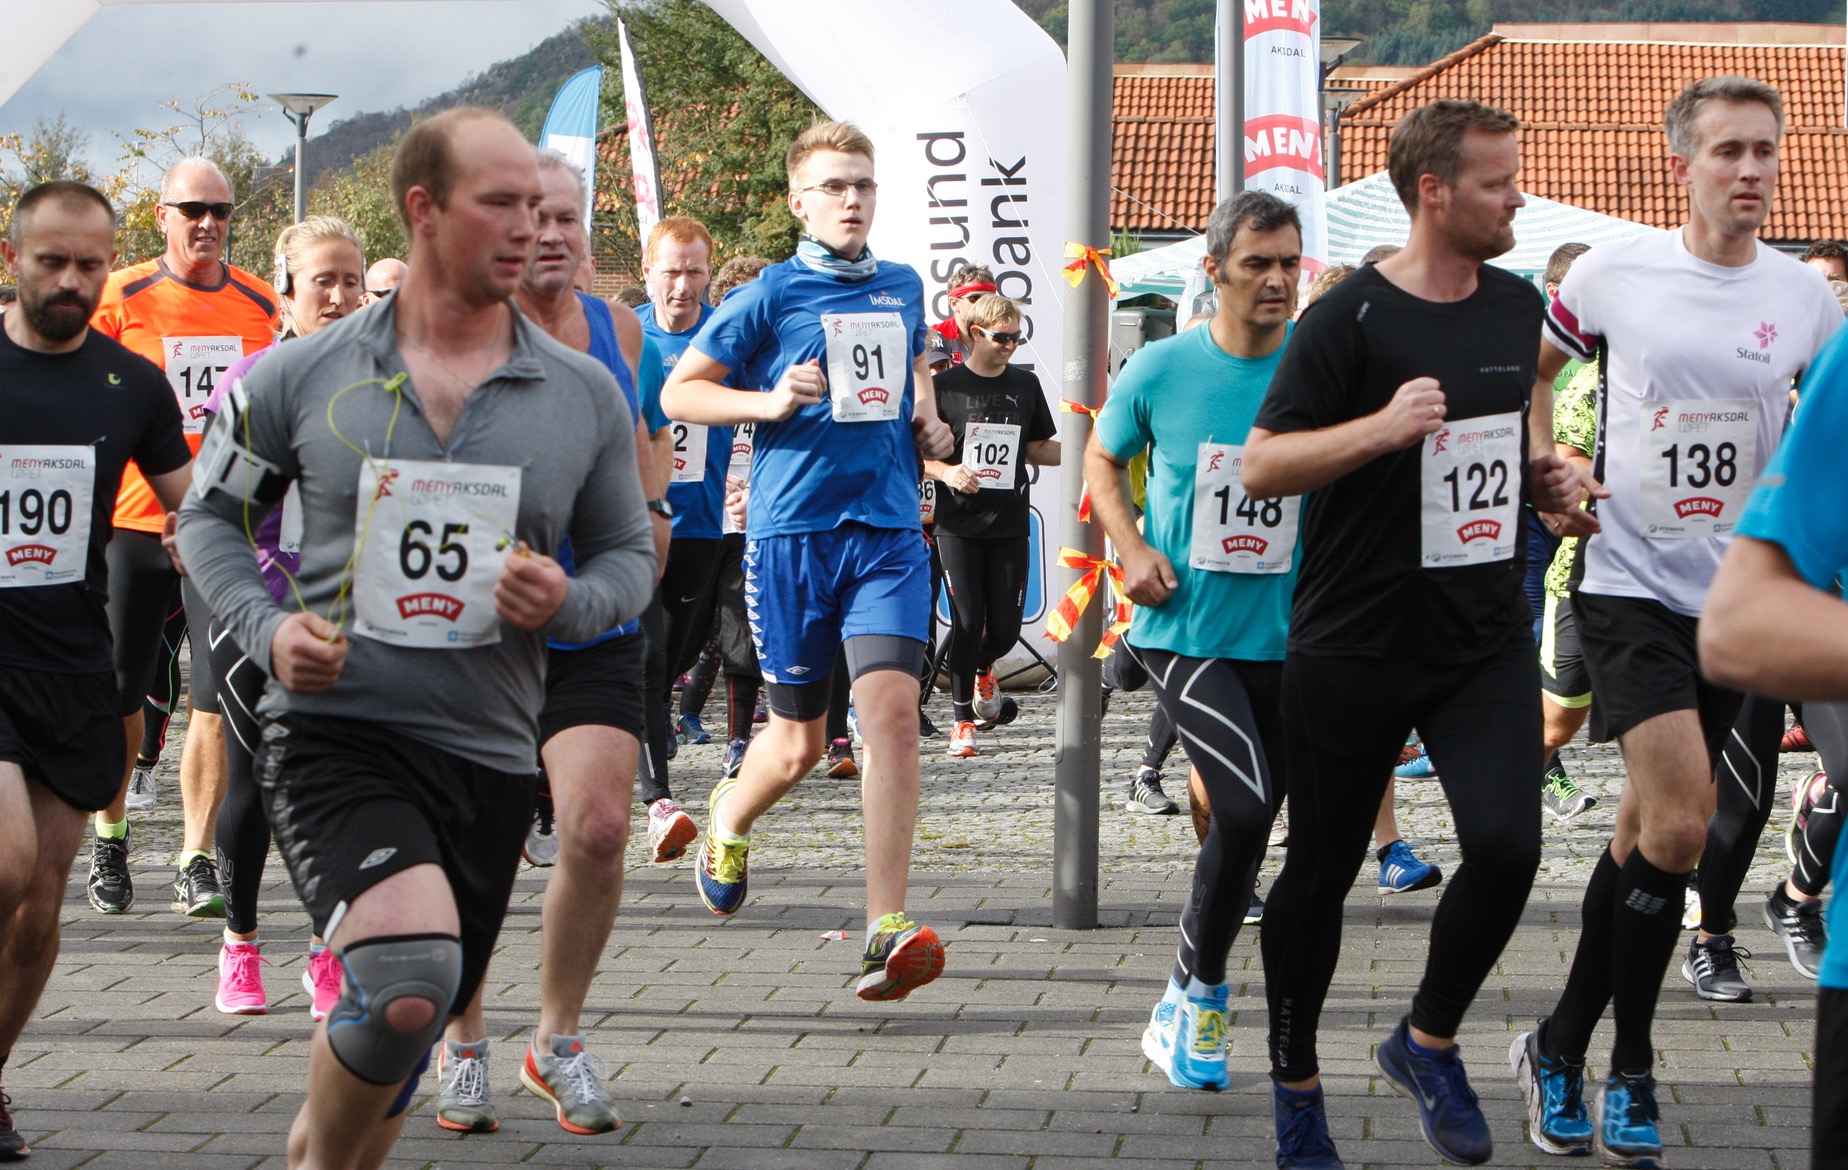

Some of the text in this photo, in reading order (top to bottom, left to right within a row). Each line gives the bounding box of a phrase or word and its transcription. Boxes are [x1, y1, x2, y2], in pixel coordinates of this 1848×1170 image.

[1245, 0, 1309, 24] MEN
[1271, 46, 1306, 57] AKSDAL
[190, 344, 238, 352] MENYAKSDAL
[1736, 347, 1771, 364] Statoil
[853, 344, 884, 380] 91
[862, 390, 887, 400] MENY
[966, 394, 1001, 409] LIVE
[1678, 412, 1749, 423] MENYAKSDAL
[1457, 427, 1515, 443] MENYAKSDAL
[974, 443, 1009, 465] 102
[11, 458, 86, 469] MENYAKSDAL
[1661, 442, 1737, 489] 138
[411, 479, 509, 498] MENYAKSDAL
[1443, 459, 1509, 513] 122
[0, 488, 72, 535] 190
[1215, 485, 1283, 528] 148
[1680, 500, 1720, 514] MENY
[1462, 523, 1498, 539] MENY
[400, 519, 469, 582] 65
[1227, 538, 1264, 550] MENY
[11, 548, 52, 562] MENY
[403, 596, 459, 614] MENY
